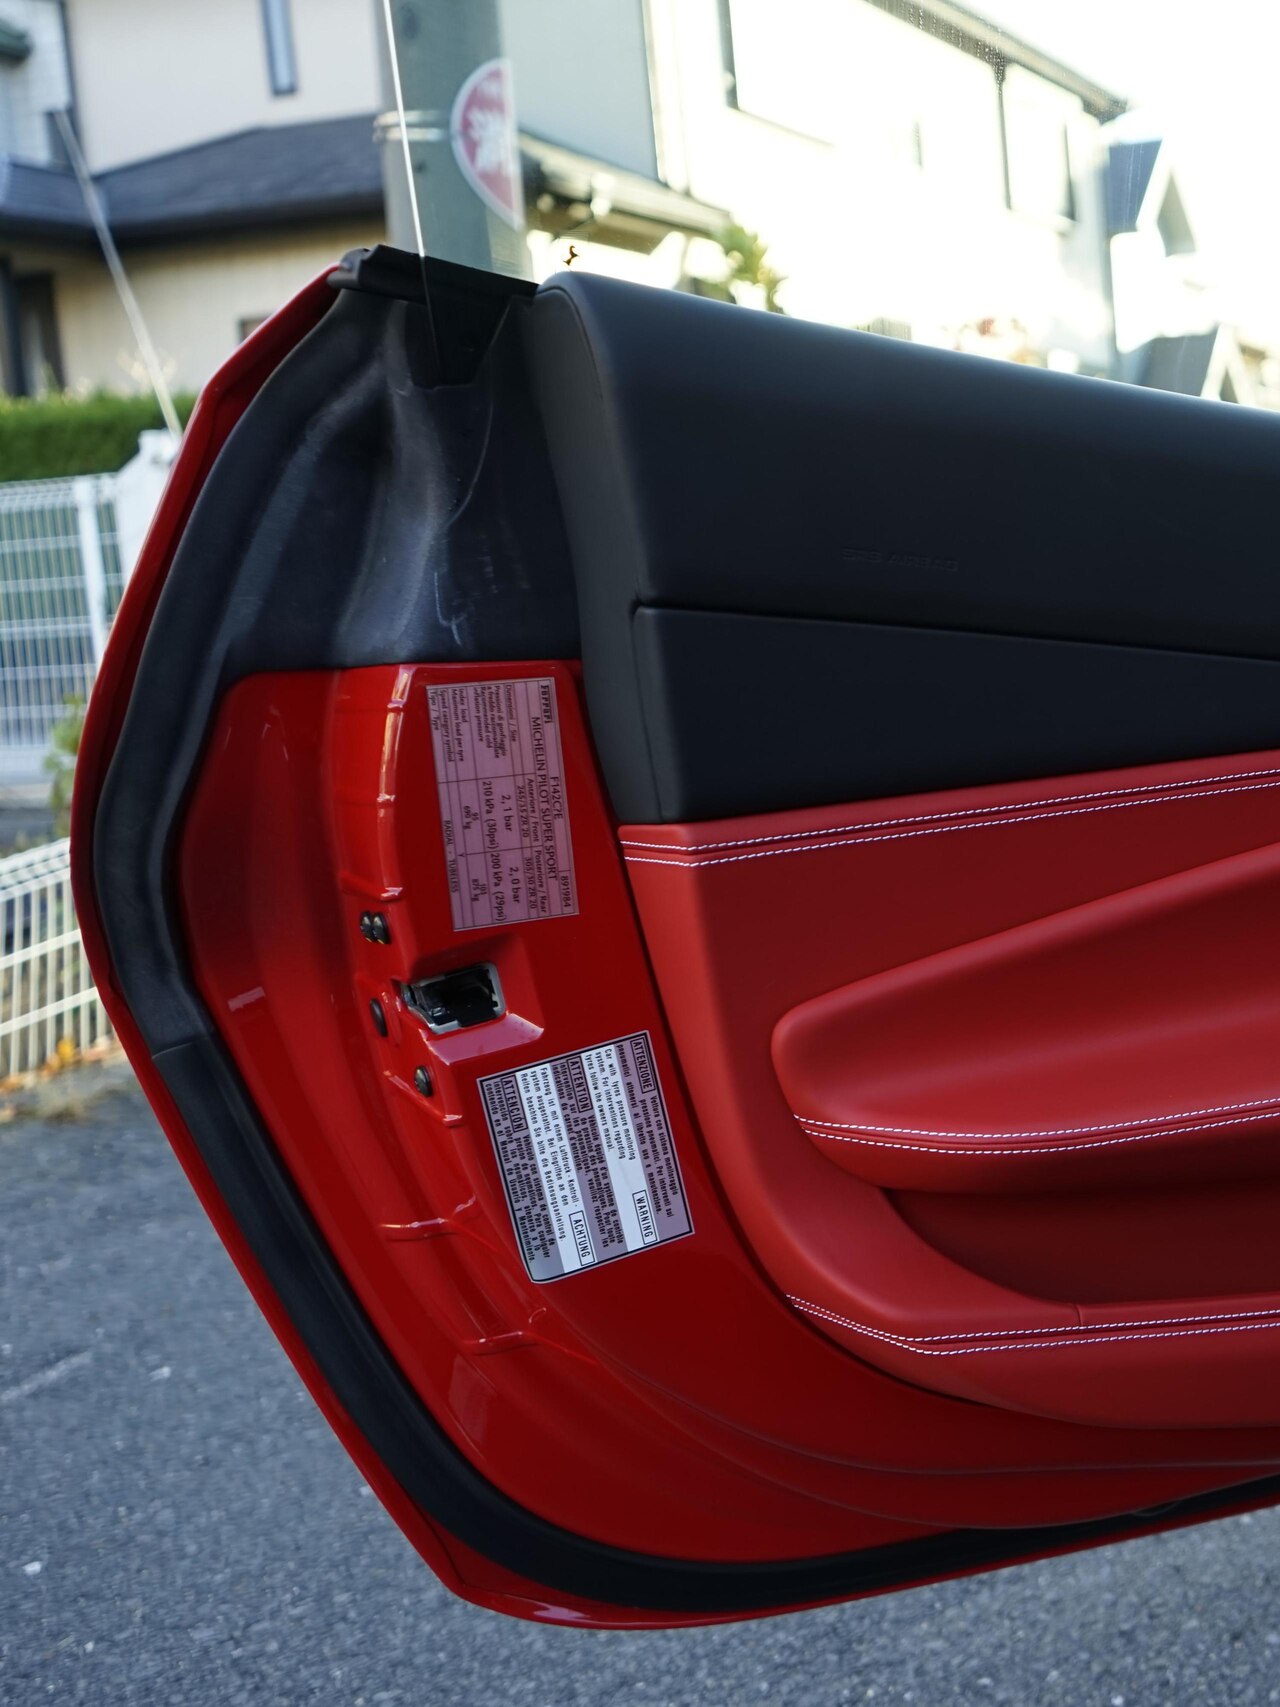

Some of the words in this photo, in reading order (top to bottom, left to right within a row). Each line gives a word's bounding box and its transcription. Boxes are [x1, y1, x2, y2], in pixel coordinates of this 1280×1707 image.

[429, 691, 438, 706] Tipo
[438, 690, 447, 709] Speed
[451, 689, 460, 720] Maximum
[458, 688, 466, 705] Index
[473, 687, 481, 713] inflation
[487, 691, 496, 712] freddo
[494, 685, 502, 713] Pressioni
[480, 687, 491, 733] Recommended
[505, 685, 515, 720] Dimensioni
[510, 730, 518, 742] Size
[432, 716, 440, 731] Type
[441, 710, 451, 738] category
[474, 715, 483, 742] pressure
[444, 739, 454, 762] symbol
[454, 738, 462, 748] per
[496, 722, 507, 756] gonfiaggio
[531, 717, 546, 771] MICHELIN
[456, 749, 464, 762] tyre
[482, 780, 493, 797] 210
[527, 778, 537, 813] Anteriore
[537, 774, 549, 805] PILOT
[484, 798, 495, 814] kPa
[444, 820, 453, 846] RADIAL
[484, 818, 499, 850] (30psi)
[504, 815, 514, 832] bar
[522, 828, 529, 838] 20
[531, 821, 540, 842] Front
[541, 808, 553, 842] SUPER
[490, 853, 501, 869] 200
[534, 850, 545, 888] Posteriore
[545, 845, 557, 881] SPORT
[492, 871, 503, 887] kPa
[492, 890, 507, 922] (29psi)
[511, 887, 522, 904] bar
[539, 895, 548, 913] Rear
[604, 1048, 613, 1060] Car
[633, 1040, 653, 1089] ATTENZIONE
[529, 1070, 541, 1093] system
[539, 1067, 553, 1096] Fahrzeug
[559, 1062, 574, 1101] intervention
[608, 1063, 617, 1077] with
[520, 1073, 531, 1093] Reifen
[569, 1060, 590, 1110] ATTENTION
[611, 1081, 621, 1097] tyres
[485, 1083, 499, 1115] contenido
[503, 1078, 526, 1129] ATTENCIÓN
[526, 1096, 539, 1124] beachten
[551, 1064, 566, 1100] indications
[564, 1113, 574, 1135] carnet
[569, 1103, 577, 1114] sur
[584, 1054, 595, 1070] tyres
[590, 1072, 599, 1091] follow
[598, 1104, 607, 1126] owners
[603, 1127, 614, 1152] manual.
[595, 1051, 606, 1075] system.
[604, 1089, 619, 1128] interventions
[613, 1130, 627, 1160] regarding
[650, 1096, 661, 1118] Vettura
[494, 1119, 501, 1127] en
[535, 1095, 552, 1135] ausgestattet.
[551, 1110, 559, 1121] mit
[572, 1117, 581, 1127] les
[580, 1117, 588, 1126] de
[616, 1100, 628, 1126] pressure
[639, 1099, 652, 1128] pressione
[534, 1127, 542, 1138] Sie
[554, 1123, 564, 1143] einem
[616, 1044, 631, 1078] pneumatici
[626, 1081, 638, 1109] attenersi
[636, 1122, 647, 1145] libretto
[647, 1171, 663, 1214] manutenzione.
[655, 1119, 663, 1131] con
[537, 1140, 546, 1155] bitte
[547, 1137, 555, 1148] Bei
[581, 1126, 594, 1154] pression
[622, 1128, 637, 1161] monitoring
[658, 1132, 669, 1155] sistema
[500, 1140, 511, 1164] Manual
[541, 1158, 549, 1168] die
[559, 1144, 572, 1173] Luftdruck
[589, 1154, 597, 1165] des
[506, 1167, 514, 1176] de
[521, 1162, 529, 1171] de
[530, 1163, 538, 1175] con
[549, 1150, 563, 1181] Eingriffen
[656, 1165, 664, 1176] Per
[663, 1157, 679, 1196] monitoraggio
[504, 1125, 514, 1144] sobre
[524, 1205, 536, 1233] atenerse
[533, 1177, 545, 1201] sistema
[558, 1183, 565, 1191] an
[567, 1178, 579, 1203] Kontroll
[509, 1178, 522, 1204] Usuario
[561, 1194, 569, 1206] den
[659, 1177, 671, 1207] interventi
[540, 1203, 548, 1212] de
[543, 1170, 568, 1242] Bedienungsanleitung.
[610, 1209, 618, 1218] de
[636, 1196, 653, 1237] WARNING
[533, 1213, 543, 1228] Para
[542, 1213, 554, 1236] control
[593, 1205, 606, 1235] respecter
[603, 1211, 612, 1226] Pour
[518, 1215, 536, 1263] Mantenimiento.
[536, 1230, 551, 1259] cualquier
[548, 1237, 556, 1246] de
[573, 1218, 590, 1258] ACHTUNG
[606, 1227, 616, 1243] toute
